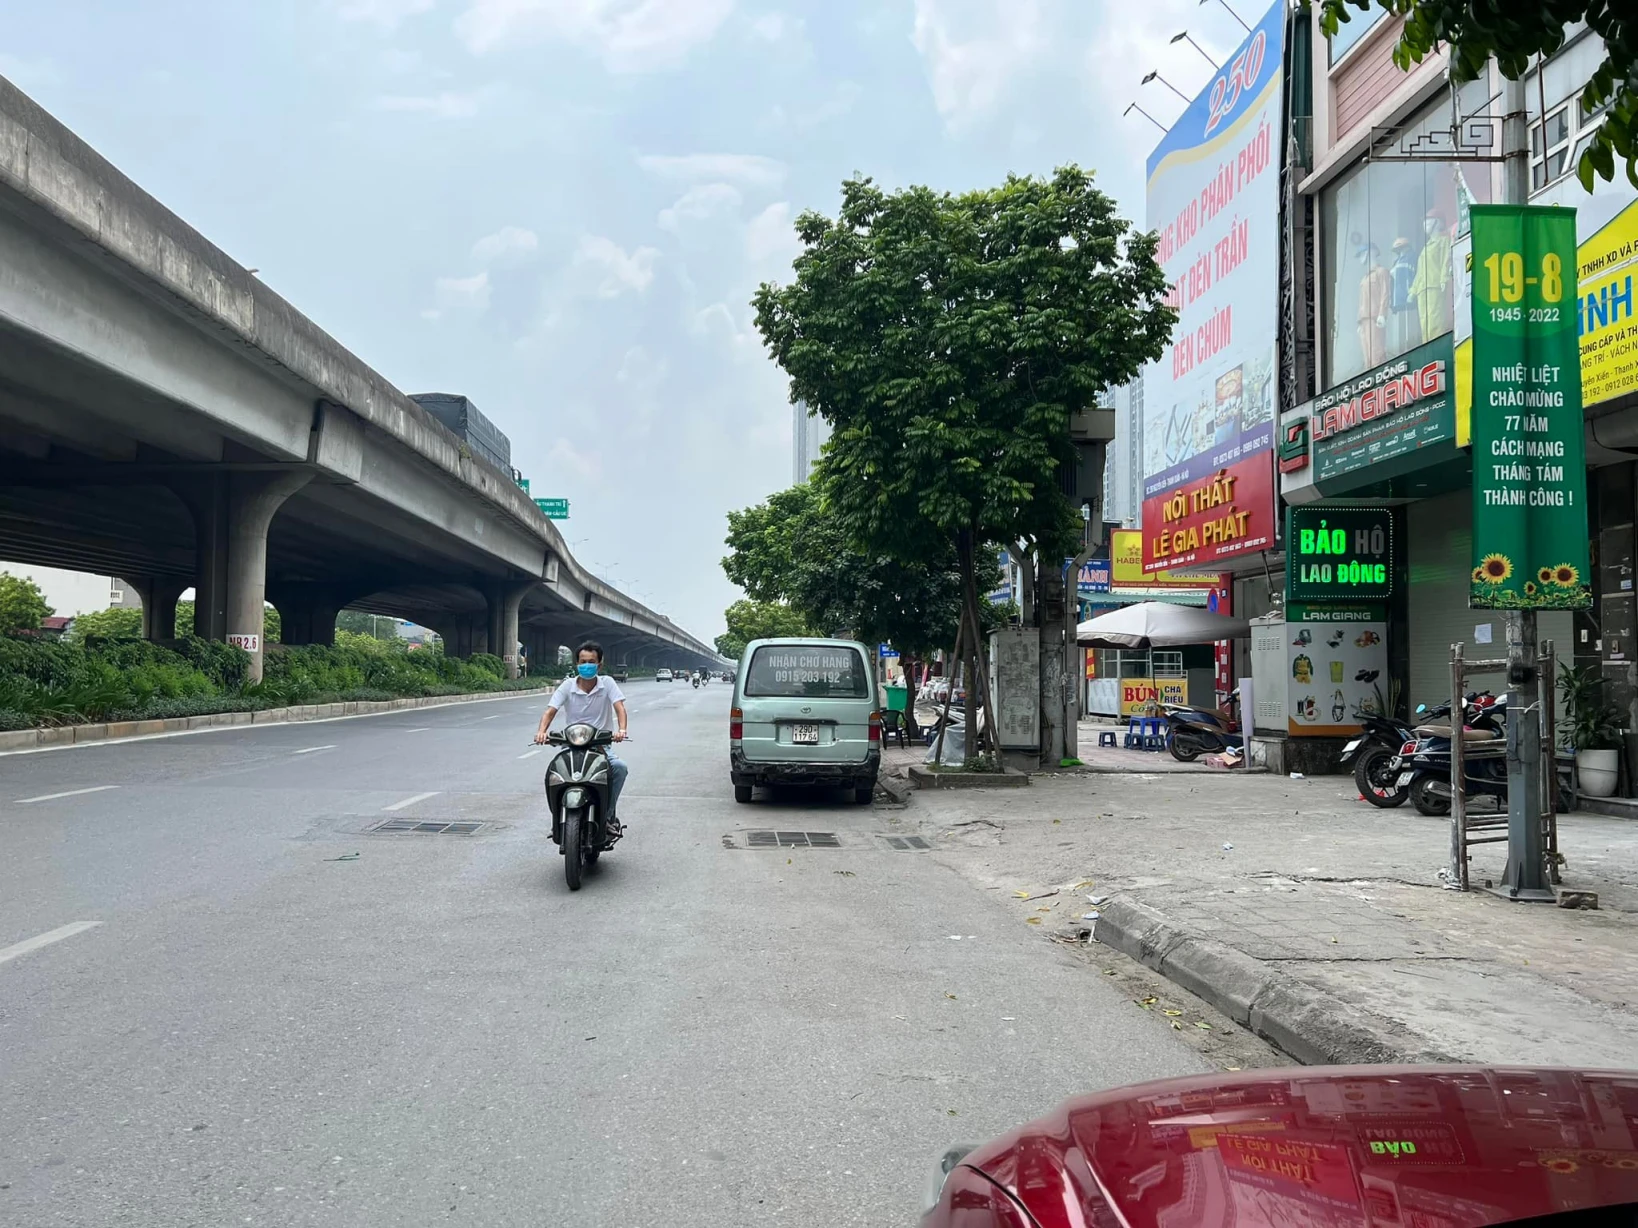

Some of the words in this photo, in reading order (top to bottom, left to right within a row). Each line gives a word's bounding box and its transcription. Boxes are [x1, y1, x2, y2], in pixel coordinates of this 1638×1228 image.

[1204, 29, 1266, 138] 250
[1177, 199, 1197, 250] KHO
[1200, 160, 1234, 228] PHÂN
[1238, 111, 1270, 192] PHỐI
[1189, 251, 1212, 304] ĐÈN
[1214, 214, 1248, 282] TRẦN
[1582, 256, 1604, 275] TNHH
[1606, 250, 1617, 265] XD
[1620, 242, 1632, 257] VÀ
[1484, 252, 1562, 303] 19-8
[1197, 305, 1231, 365] CHÙM
[1615, 328, 1626, 342] VÀ
[1582, 358, 1592, 369] NG
[1594, 350, 1605, 365] TRÍ
[1610, 343, 1630, 359] VÁCH
[1492, 362, 1527, 384] NHIỆT
[1532, 364, 1560, 386] LIỆT
[1614, 361, 1634, 376] Thanh
[1315, 393, 1334, 412] BẢO
[1336, 385, 1351, 402] HỘ
[1352, 376, 1375, 394] LAO
[1375, 361, 1408, 383] ĐỘNG
[1489, 387, 1524, 407] CHÀO
[1526, 388, 1564, 408] MỪNG
[1590, 386, 1600, 397] 192
[1604, 379, 1620, 392] 0912
[1622, 374, 1634, 386] 028
[1312, 398, 1359, 441] LAM
[1360, 360, 1443, 421] GIANG
[1404, 412, 1414, 420] LAO
[1504, 415, 1520, 431] 77
[1524, 414, 1548, 432] NĂM
[1492, 436, 1524, 456] CÁCH
[1526, 441, 1564, 460] MẠNG
[1492, 461, 1531, 481] THÁNG
[1536, 462, 1564, 482] TÁM
[1163, 490, 1188, 525] NỘI
[1191, 469, 1237, 513] THẤT
[1483, 486, 1526, 506] THÀNH
[1529, 486, 1564, 506] CÔNG
[1153, 528, 1170, 558] LÊ
[1173, 526, 1200, 554] GIA
[1202, 506, 1249, 546] PHÁT
[1300, 520, 1346, 554] BẢO
[1355, 524, 1384, 558] HỘ
[1300, 564, 1332, 582] LAO
[1337, 560, 1386, 586] ĐỘNG
[1302, 612, 1330, 620] LAM
[1332, 612, 1371, 620] GIANG
[769, 653, 796, 669] NHẬN
[822, 654, 850, 668] HÀNG
[776, 670, 800, 682] 0915
[802, 671, 820, 682] 203
[822, 672, 840, 683] 192
[1124, 683, 1159, 702] BÚN
